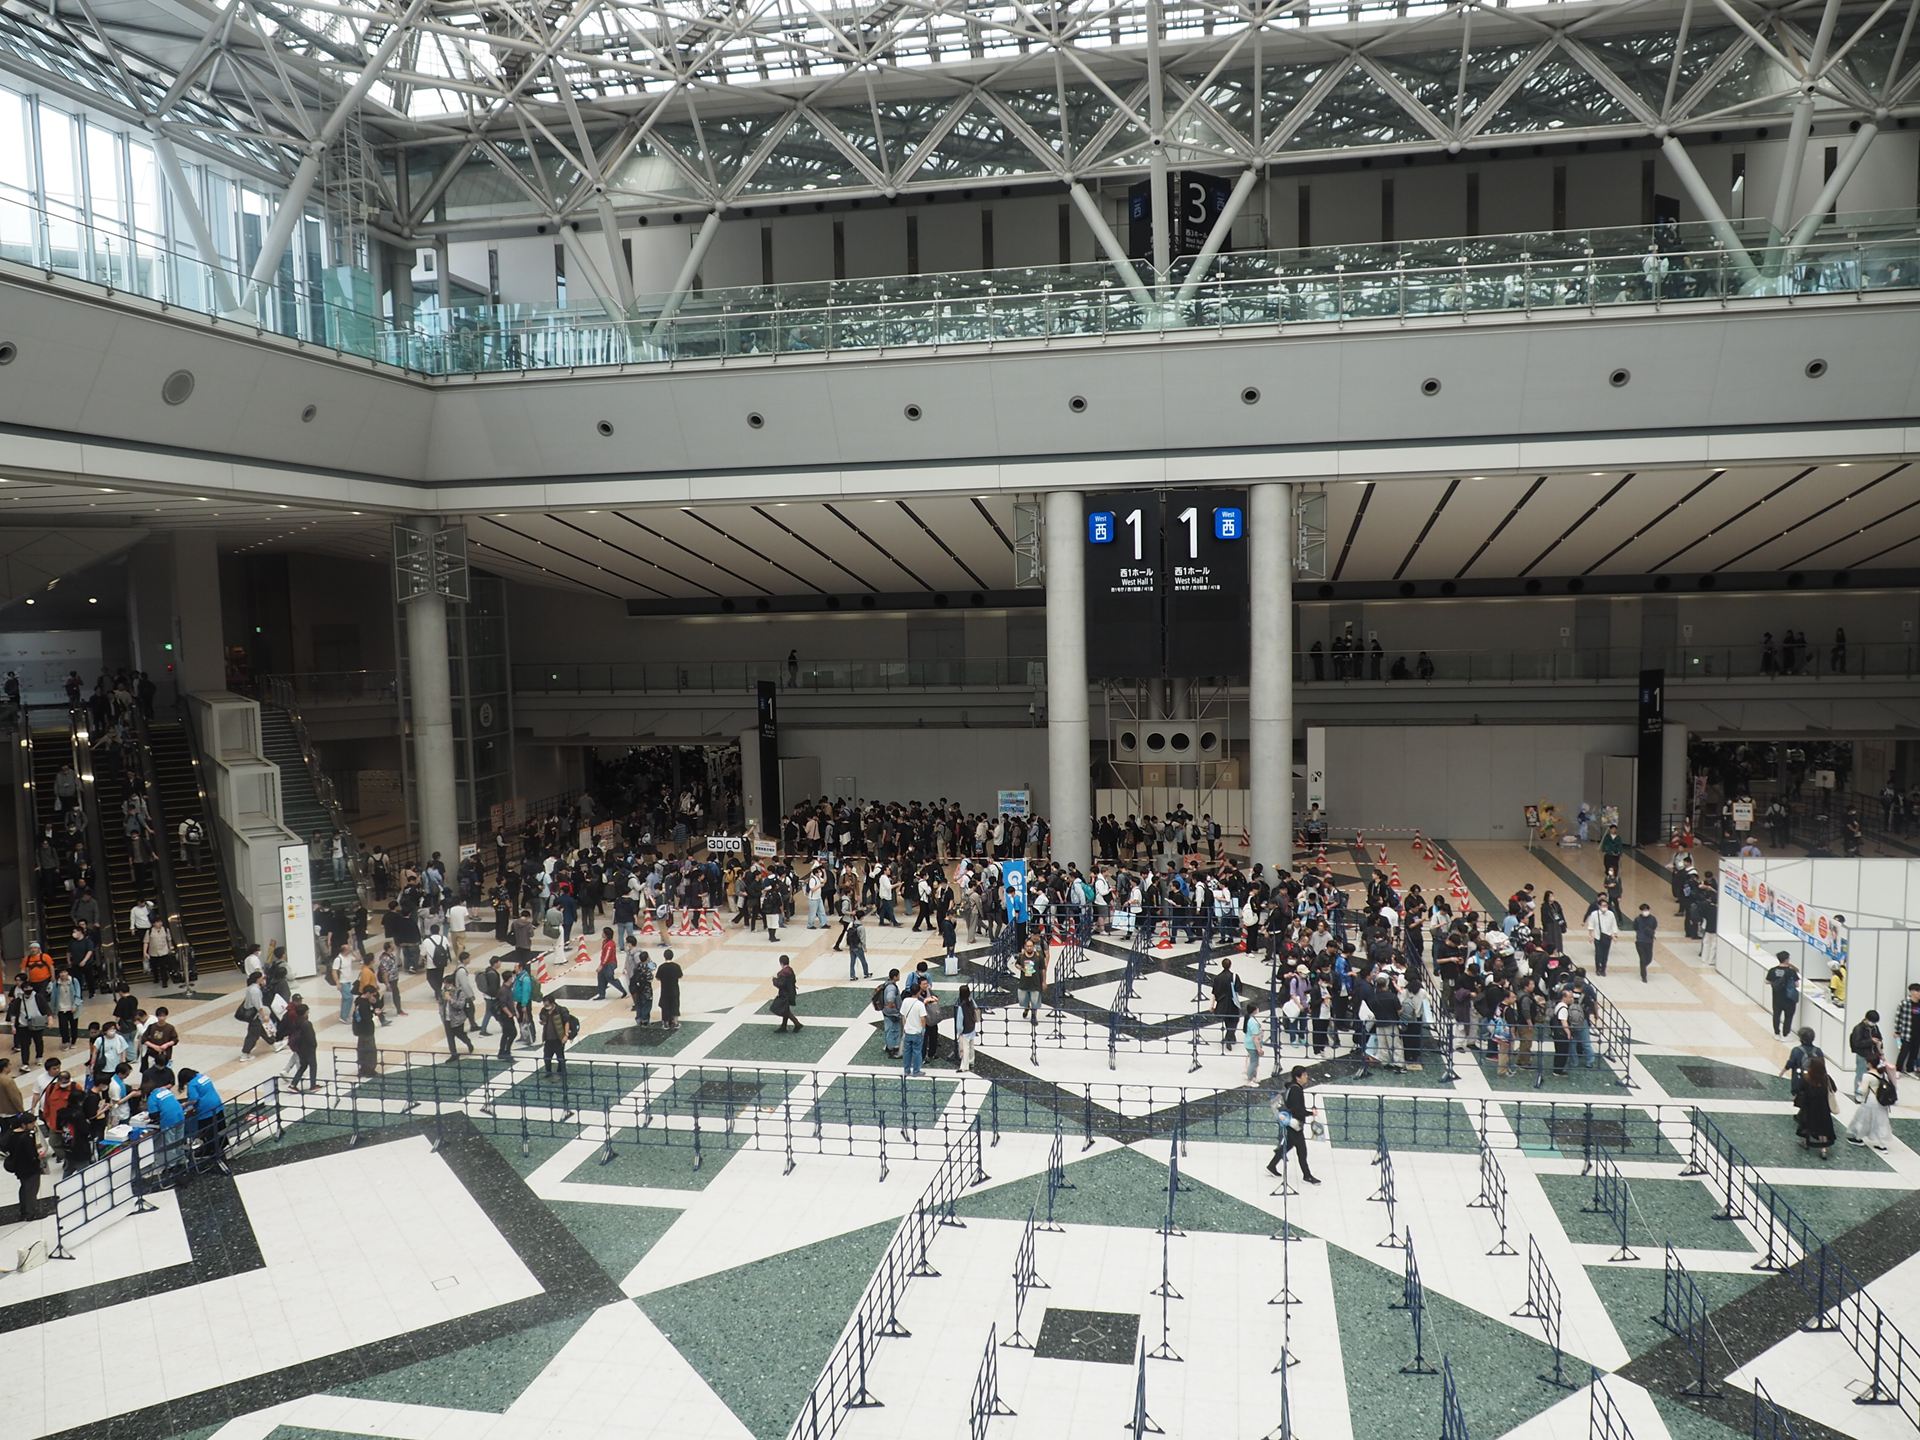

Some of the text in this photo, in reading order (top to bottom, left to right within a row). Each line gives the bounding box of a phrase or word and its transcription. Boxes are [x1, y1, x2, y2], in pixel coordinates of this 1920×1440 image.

[1188, 182, 1207, 224] 3
[1095, 523, 1107, 540] 西
[1125, 509, 1142, 560] 1
[1177, 507, 1198, 558] 1
[1222, 519, 1235, 537] 西
[1120, 567, 1153, 578] 西1ホール
[1174, 566, 1210, 576] 西1ホール
[1121, 578, 1136, 586] West
[1136, 577, 1149, 585] Hall
[1174, 576, 1190, 585] West
[1191, 576, 1204, 585] Hall
[767, 697, 773, 720] 1
[1654, 687, 1660, 712] 1
